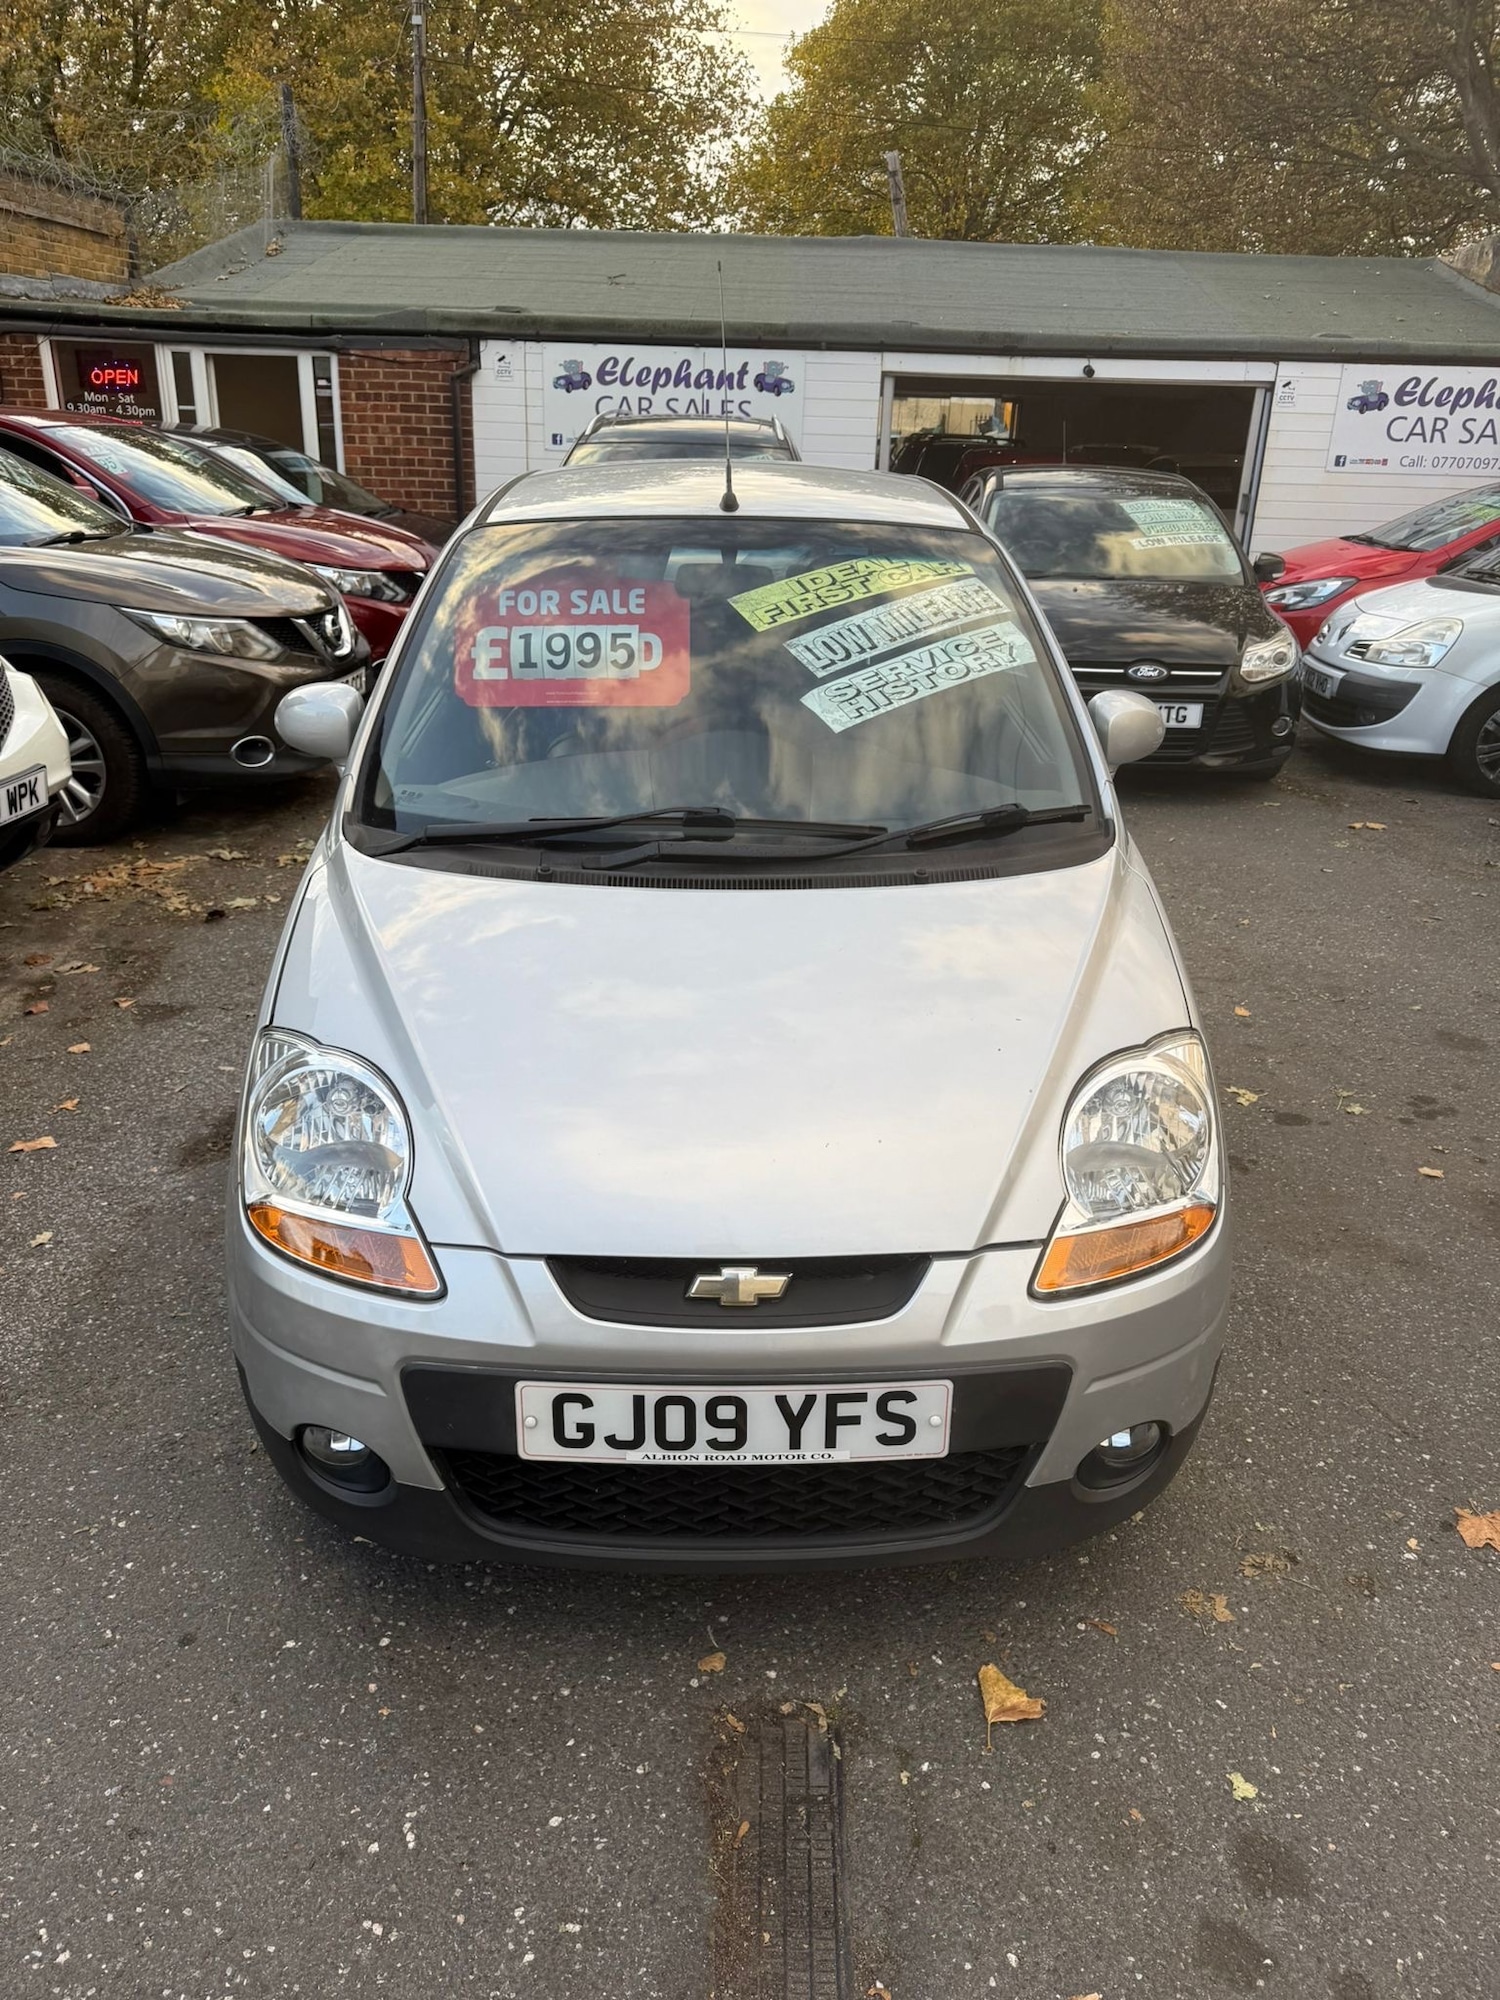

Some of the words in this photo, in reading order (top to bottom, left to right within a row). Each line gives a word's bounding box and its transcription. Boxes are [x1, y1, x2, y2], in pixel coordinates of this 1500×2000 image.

[91, 369, 138, 385] OPEN
[596, 356, 749, 395] Elephant
[84, 391, 108, 402] Mon
[118, 393, 134, 403] Sat
[595, 396, 653, 415] CAR
[1394, 376, 1500, 416] Eleph
[67, 403, 106, 414] 9.30am
[116, 405, 155, 418] 4.30pm
[1386, 416, 1449, 443] CAR
[1400, 456, 1427, 468] Call:
[1431, 457, 1500, 470] 07707097
[1138, 537, 1166, 547] LOW
[1168, 533, 1222, 544] MILEAGE
[785, 556, 911, 595] IDEAL
[499, 590, 560, 615] FOR
[570, 589, 645, 615] SALE
[753, 576, 875, 625] FIRST
[878, 559, 967, 586] CAR
[795, 623, 878, 671] LOW
[864, 585, 1002, 642] MILEAGE
[825, 630, 1002, 702] SERVICE
[1137, 666, 1160, 677] Ford
[838, 643, 1017, 720] HISTORY
[1159, 706, 1188, 723] TG
[7, 777, 39, 815] WPK
[552, 1393, 748, 1451] GJ09
[774, 1390, 918, 1450] YFS
[642, 1453, 700, 1461] ALBION
[705, 1453, 747, 1461] ROAD
[751, 1453, 807, 1461] MOTOR
[811, 1452, 834, 1460] CO.
